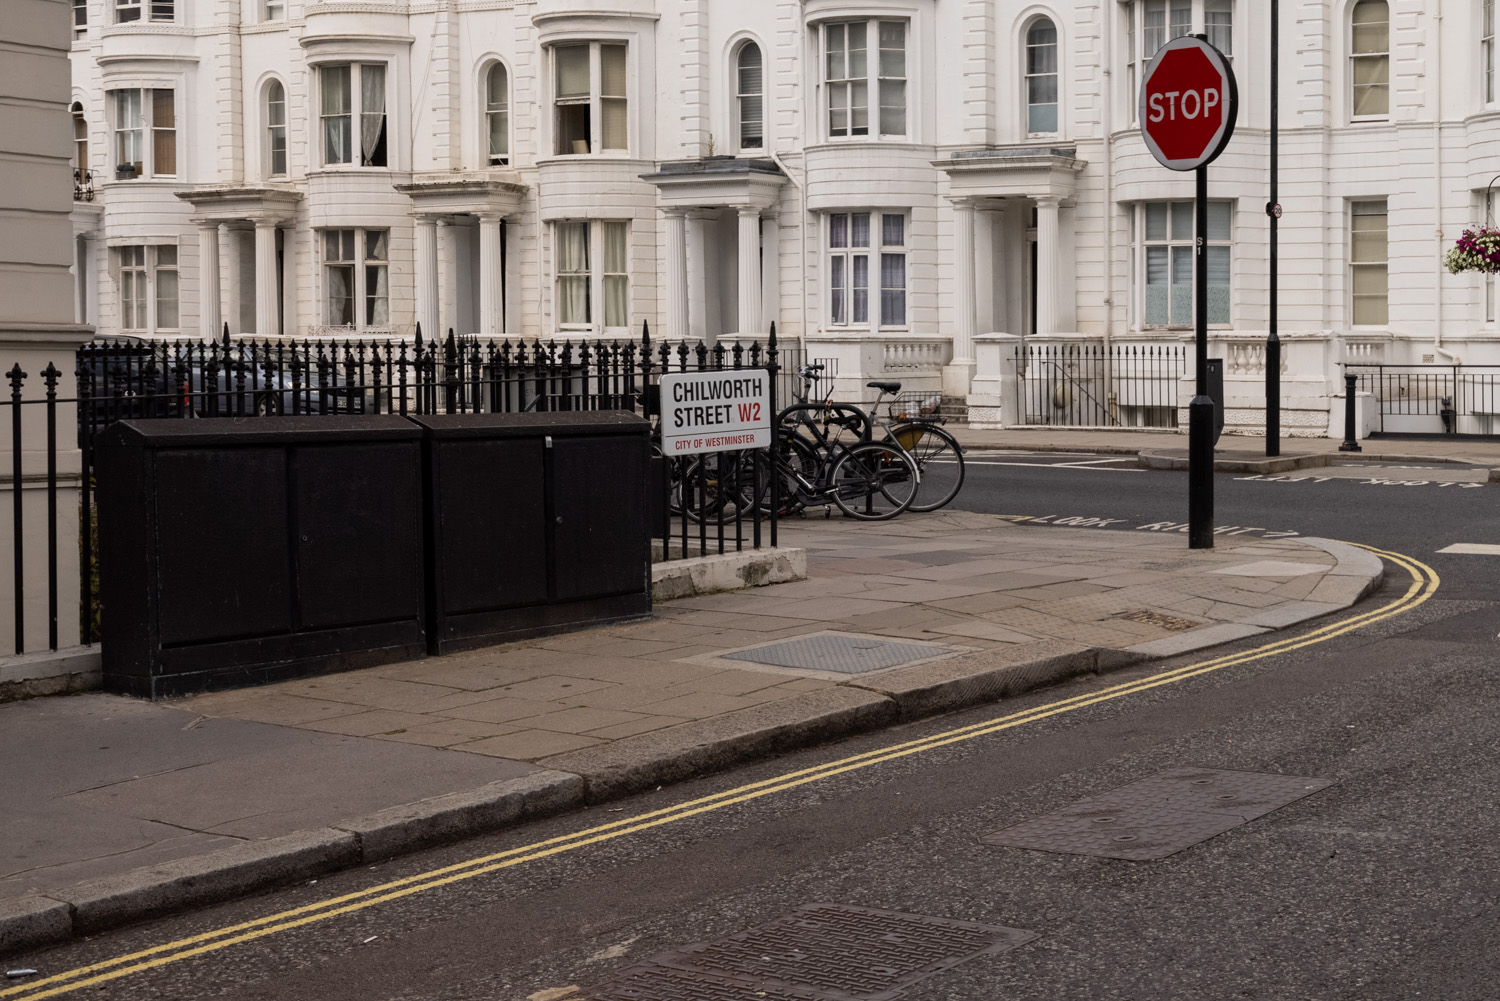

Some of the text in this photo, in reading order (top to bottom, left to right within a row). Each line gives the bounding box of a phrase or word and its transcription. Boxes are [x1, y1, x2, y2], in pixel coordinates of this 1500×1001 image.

[1148, 88, 1219, 123] STOP
[673, 378, 762, 403] CHILWORTH
[674, 402, 761, 428] STREET W2
[675, 434, 755, 450] CITY OF WESTMINSTER
[1030, 514, 1128, 528] LOOK
